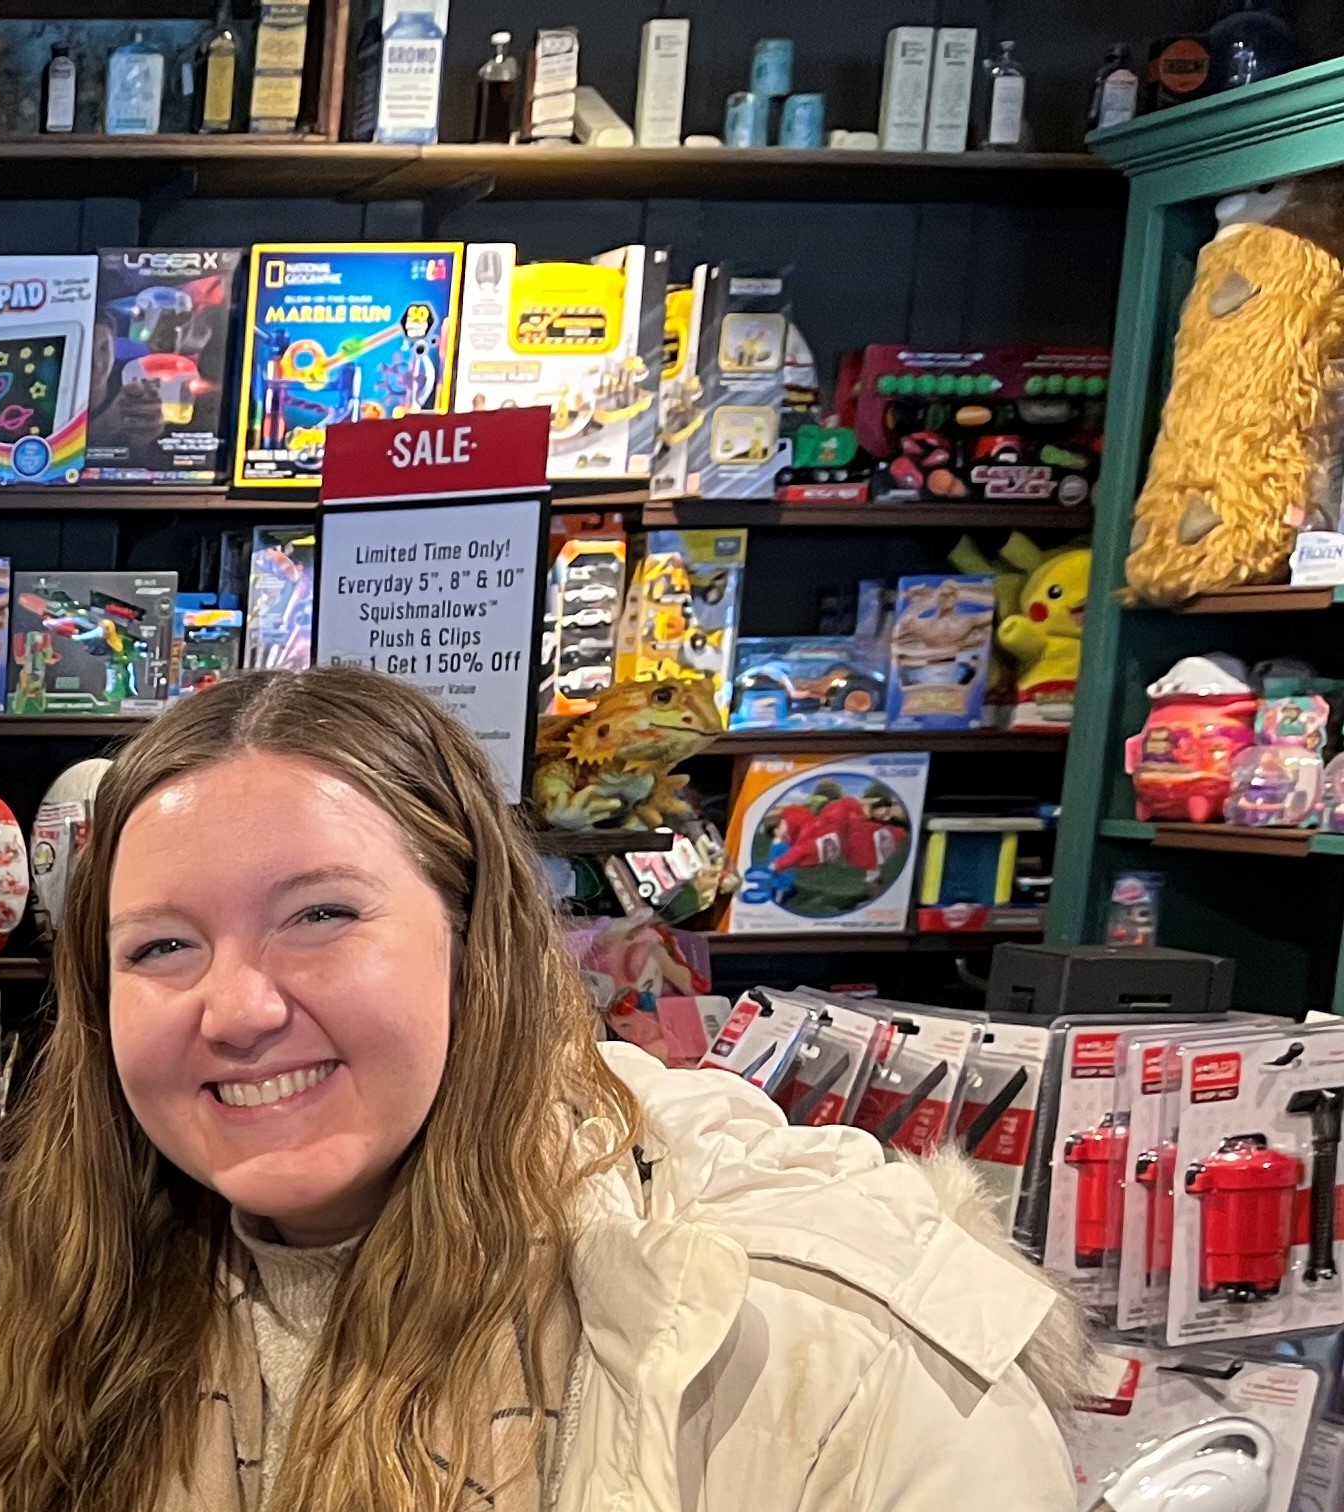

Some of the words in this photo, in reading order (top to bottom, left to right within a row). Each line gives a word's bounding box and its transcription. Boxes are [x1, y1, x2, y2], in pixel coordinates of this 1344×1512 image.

[265, 305, 347, 323] MARBLE
[349, 305, 392, 322] RUN
[392, 427, 472, 468] SALE
[356, 543, 416, 564] Limited
[423, 542, 461, 561] Time
[468, 539, 511, 562] Only!
[338, 575, 413, 597] Everyday
[476, 571, 488, 588] &
[369, 628, 414, 648] Plush
[420, 629, 431, 647] &
[439, 627, 481, 649] Clips
[387, 653, 417, 675] Get
[438, 652, 483, 673] 50%
[491, 651, 521, 672] Off
